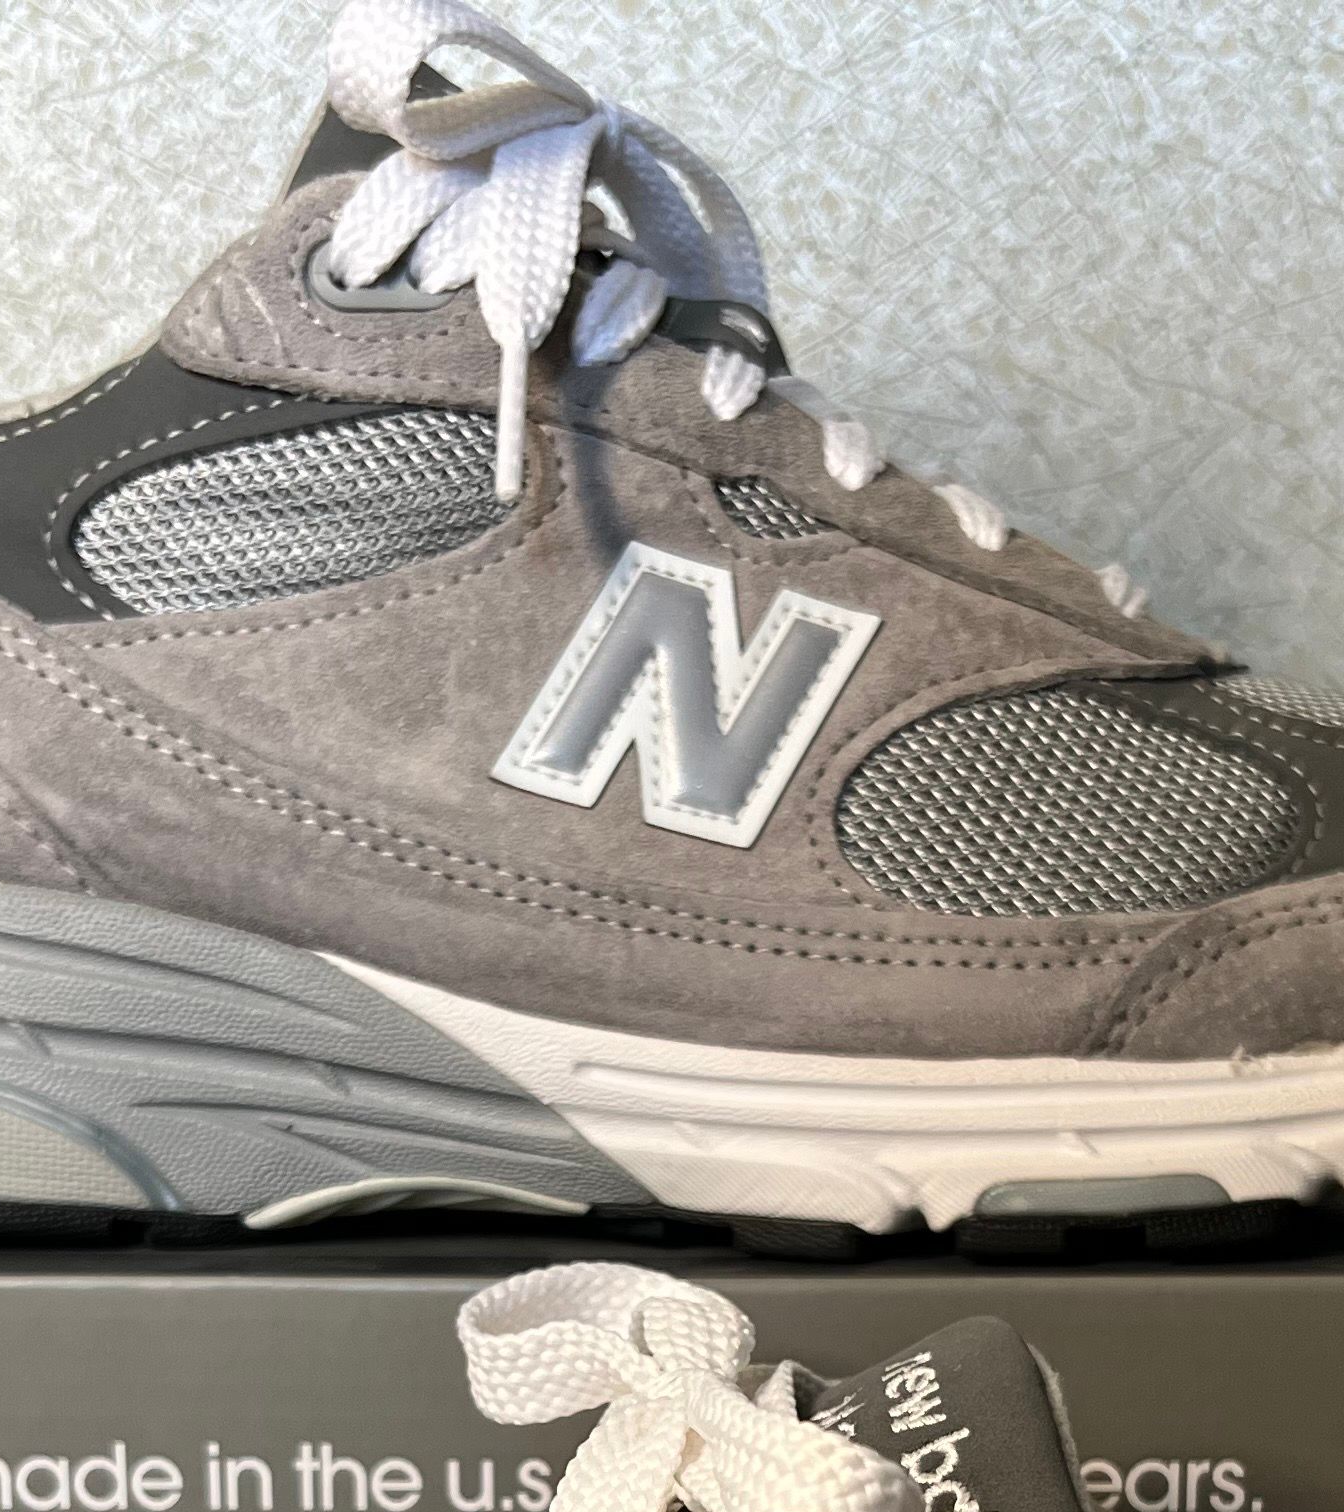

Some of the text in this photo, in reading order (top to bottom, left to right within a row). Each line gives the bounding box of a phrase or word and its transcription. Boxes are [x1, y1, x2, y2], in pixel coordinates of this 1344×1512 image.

[489, 540, 882, 849] N
[881, 1351, 947, 1433] new
[207, 1442, 274, 1512] in
[294, 1440, 424, 1512] the
[446, 1458, 554, 1512] u.s
